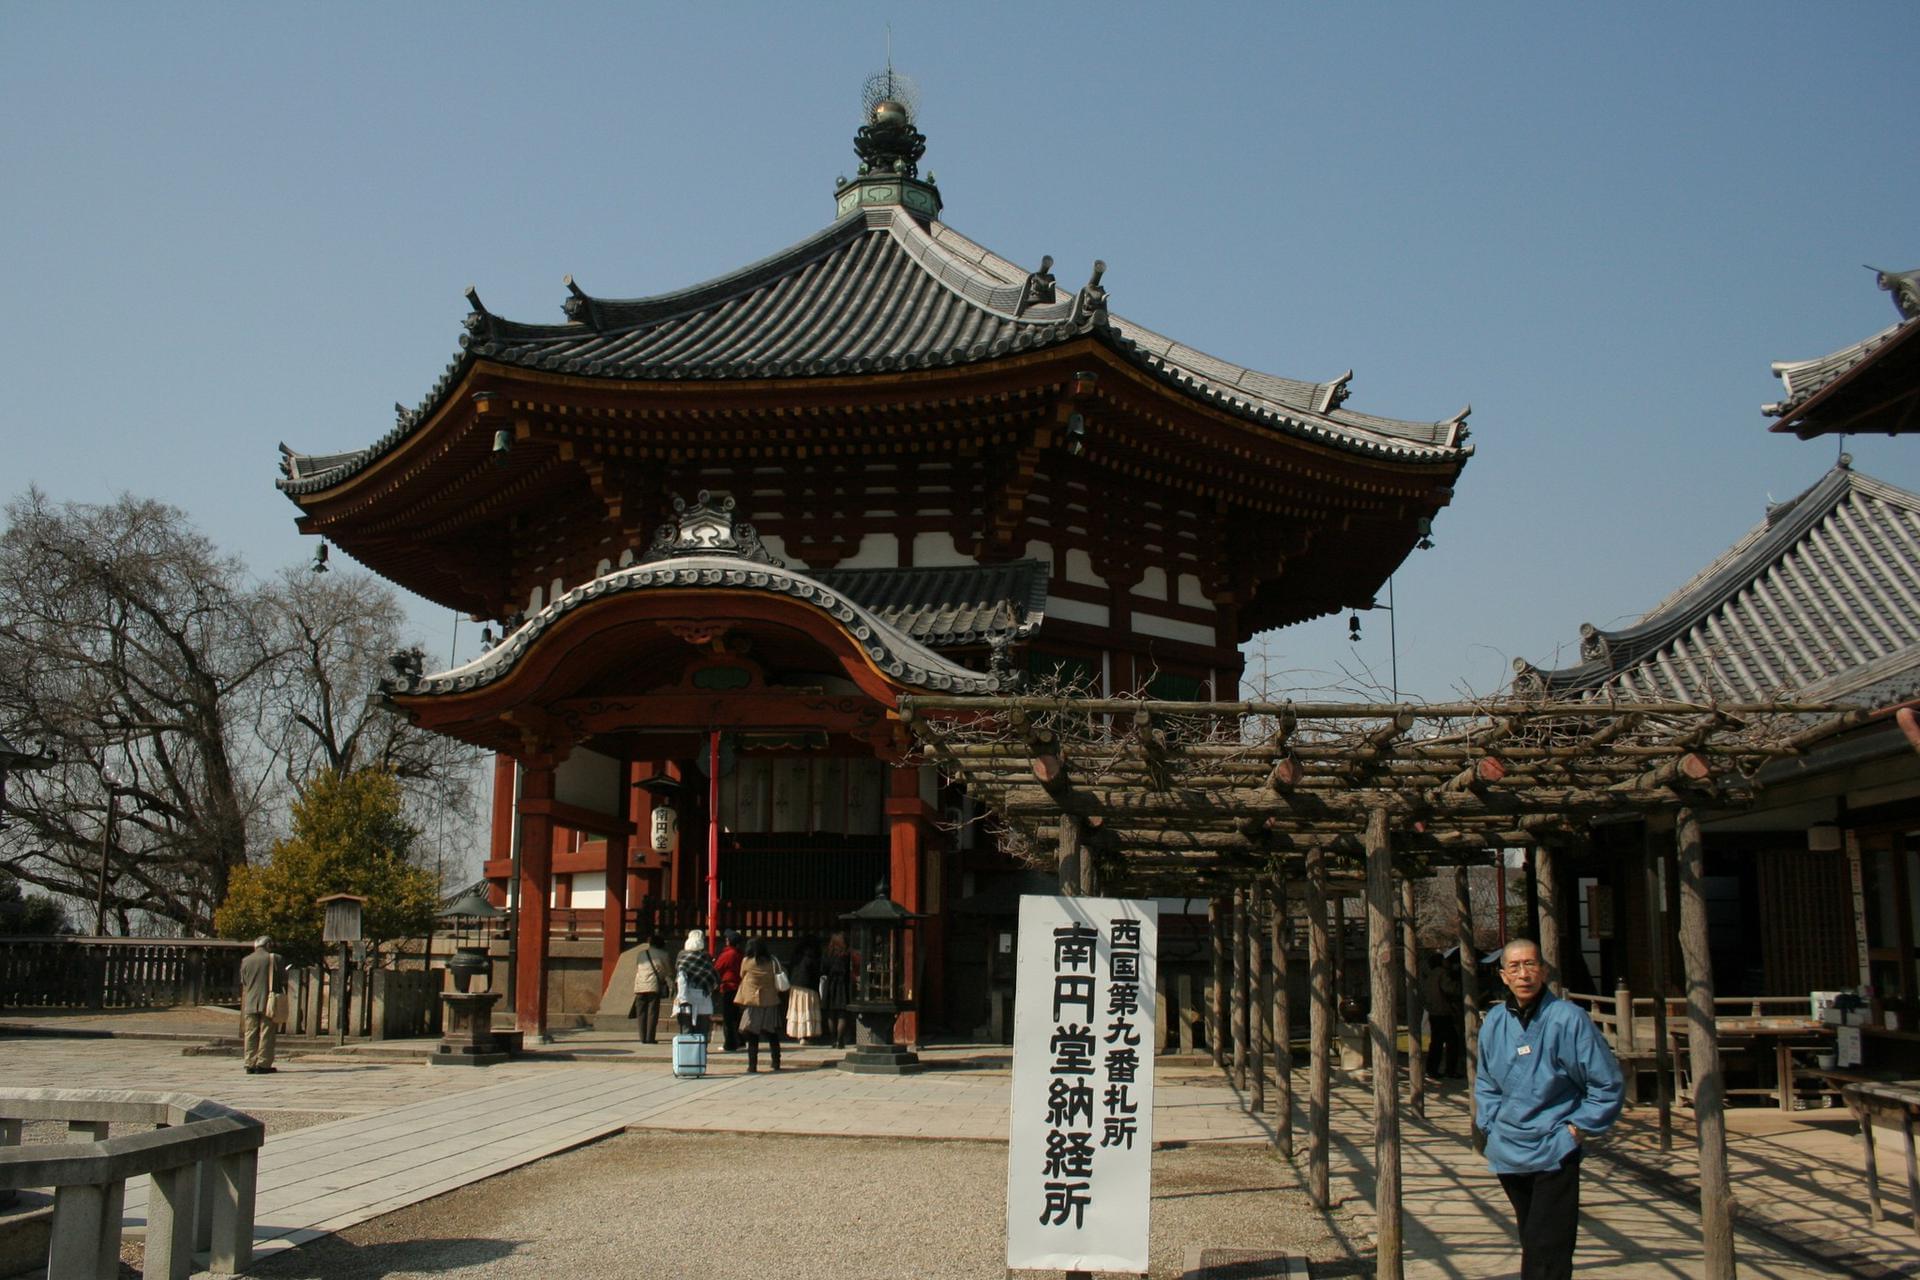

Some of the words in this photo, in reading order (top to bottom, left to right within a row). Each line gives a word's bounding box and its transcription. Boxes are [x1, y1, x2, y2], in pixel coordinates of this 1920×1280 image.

[656, 809, 668, 848] 南円堂
[1039, 921, 1099, 1230] 南円堂納経所
[1100, 919, 1141, 1150] 西国第九番札所
